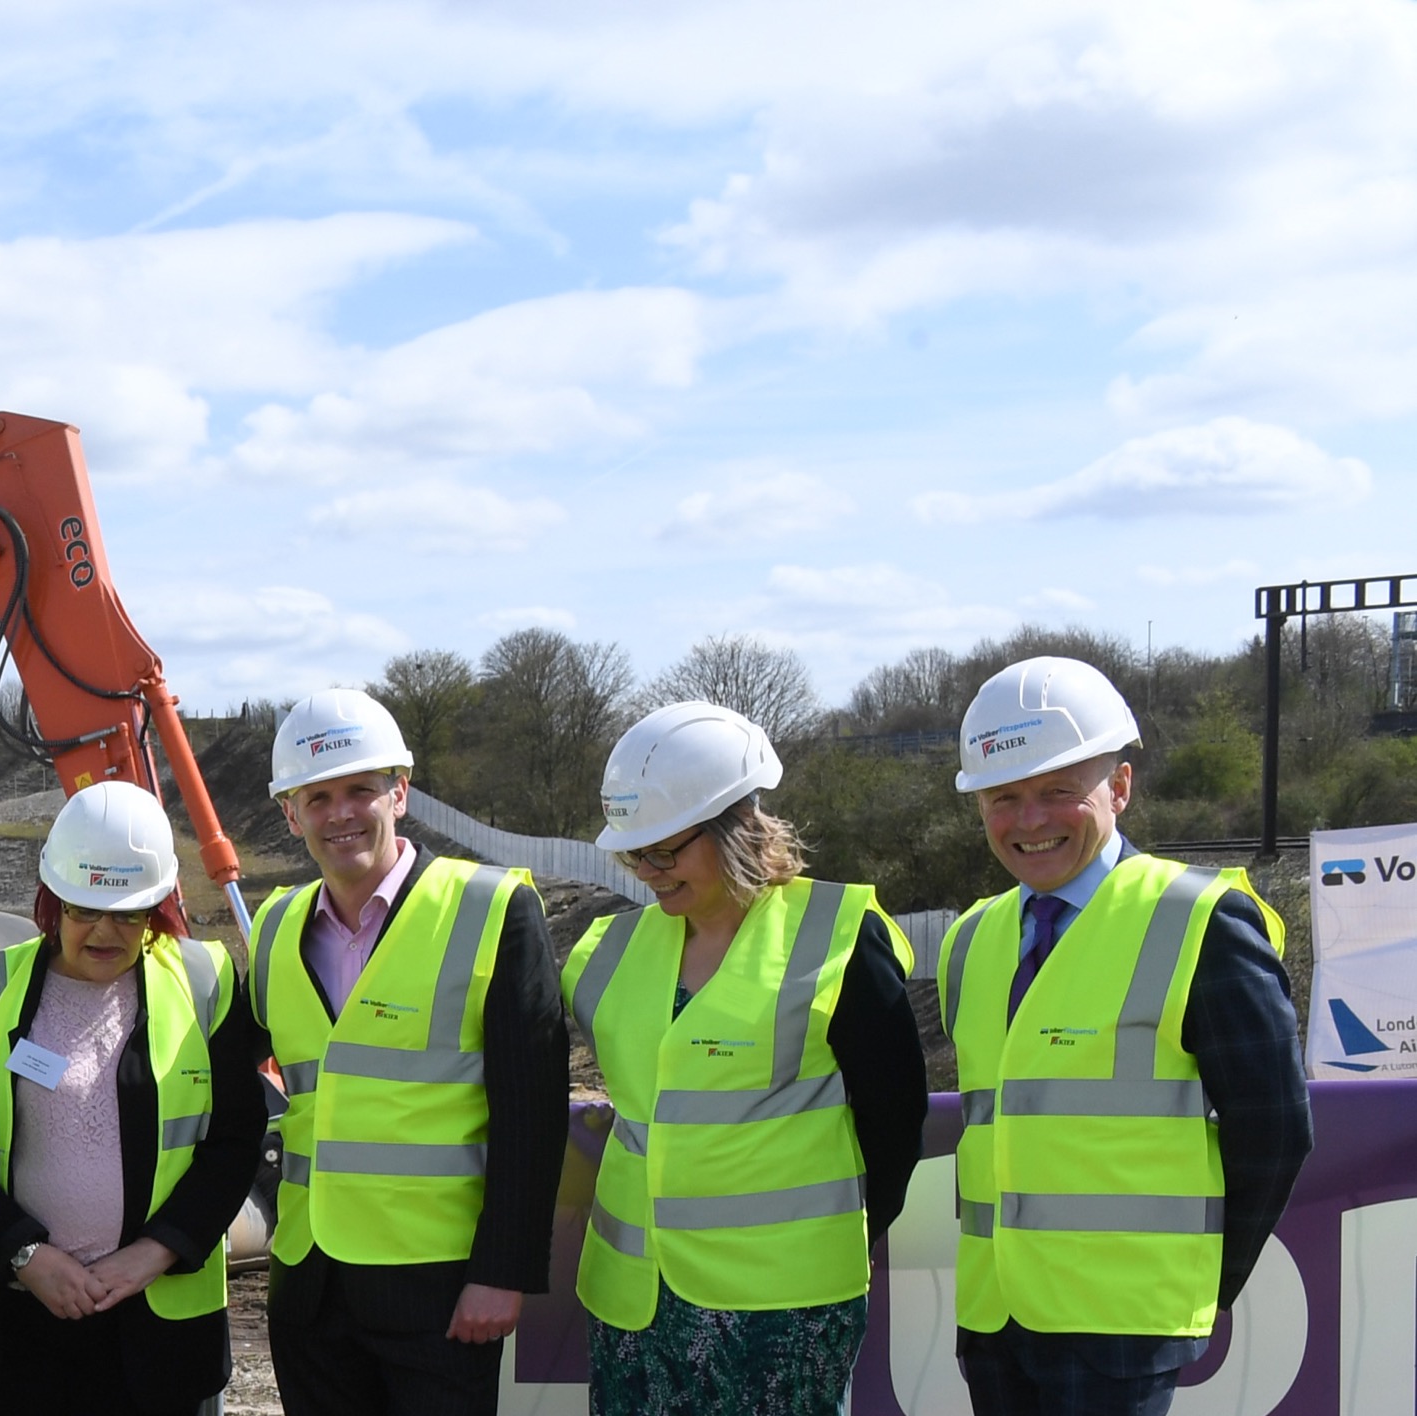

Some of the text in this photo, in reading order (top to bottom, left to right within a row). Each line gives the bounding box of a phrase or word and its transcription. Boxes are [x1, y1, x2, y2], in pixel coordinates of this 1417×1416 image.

[60, 516, 95, 591] eco
[325, 738, 352, 751] KIER
[996, 736, 1027, 752] KIER
[103, 877, 129, 887] KIER
